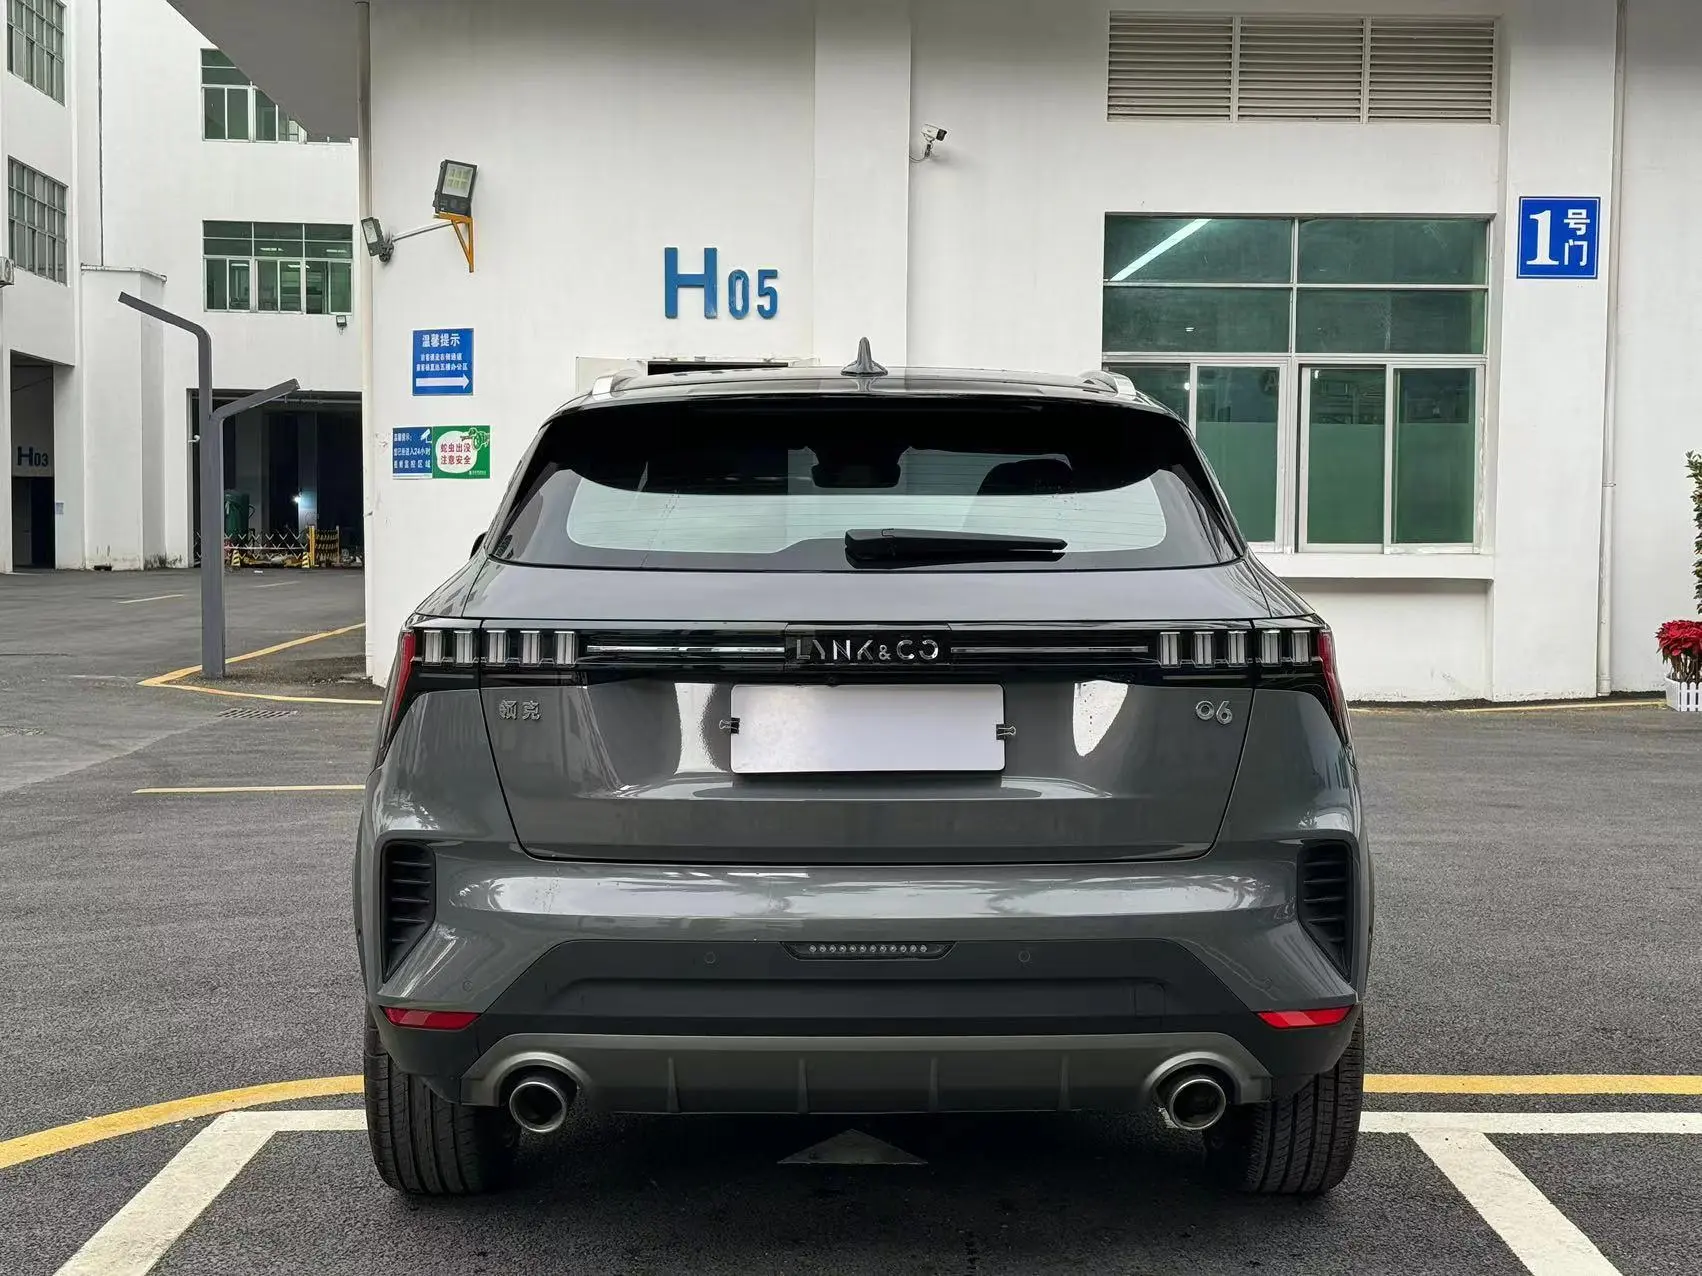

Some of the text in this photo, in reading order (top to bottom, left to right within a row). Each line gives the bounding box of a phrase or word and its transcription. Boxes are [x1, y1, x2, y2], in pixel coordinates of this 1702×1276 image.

[664, 246, 778, 320] H05
[422, 333, 461, 348] 温馨提示
[17, 446, 49, 467] H03
[440, 443, 471, 453] 蛇虫出没
[440, 455, 471, 465] 注意安全
[499, 699, 541, 721] 领克
